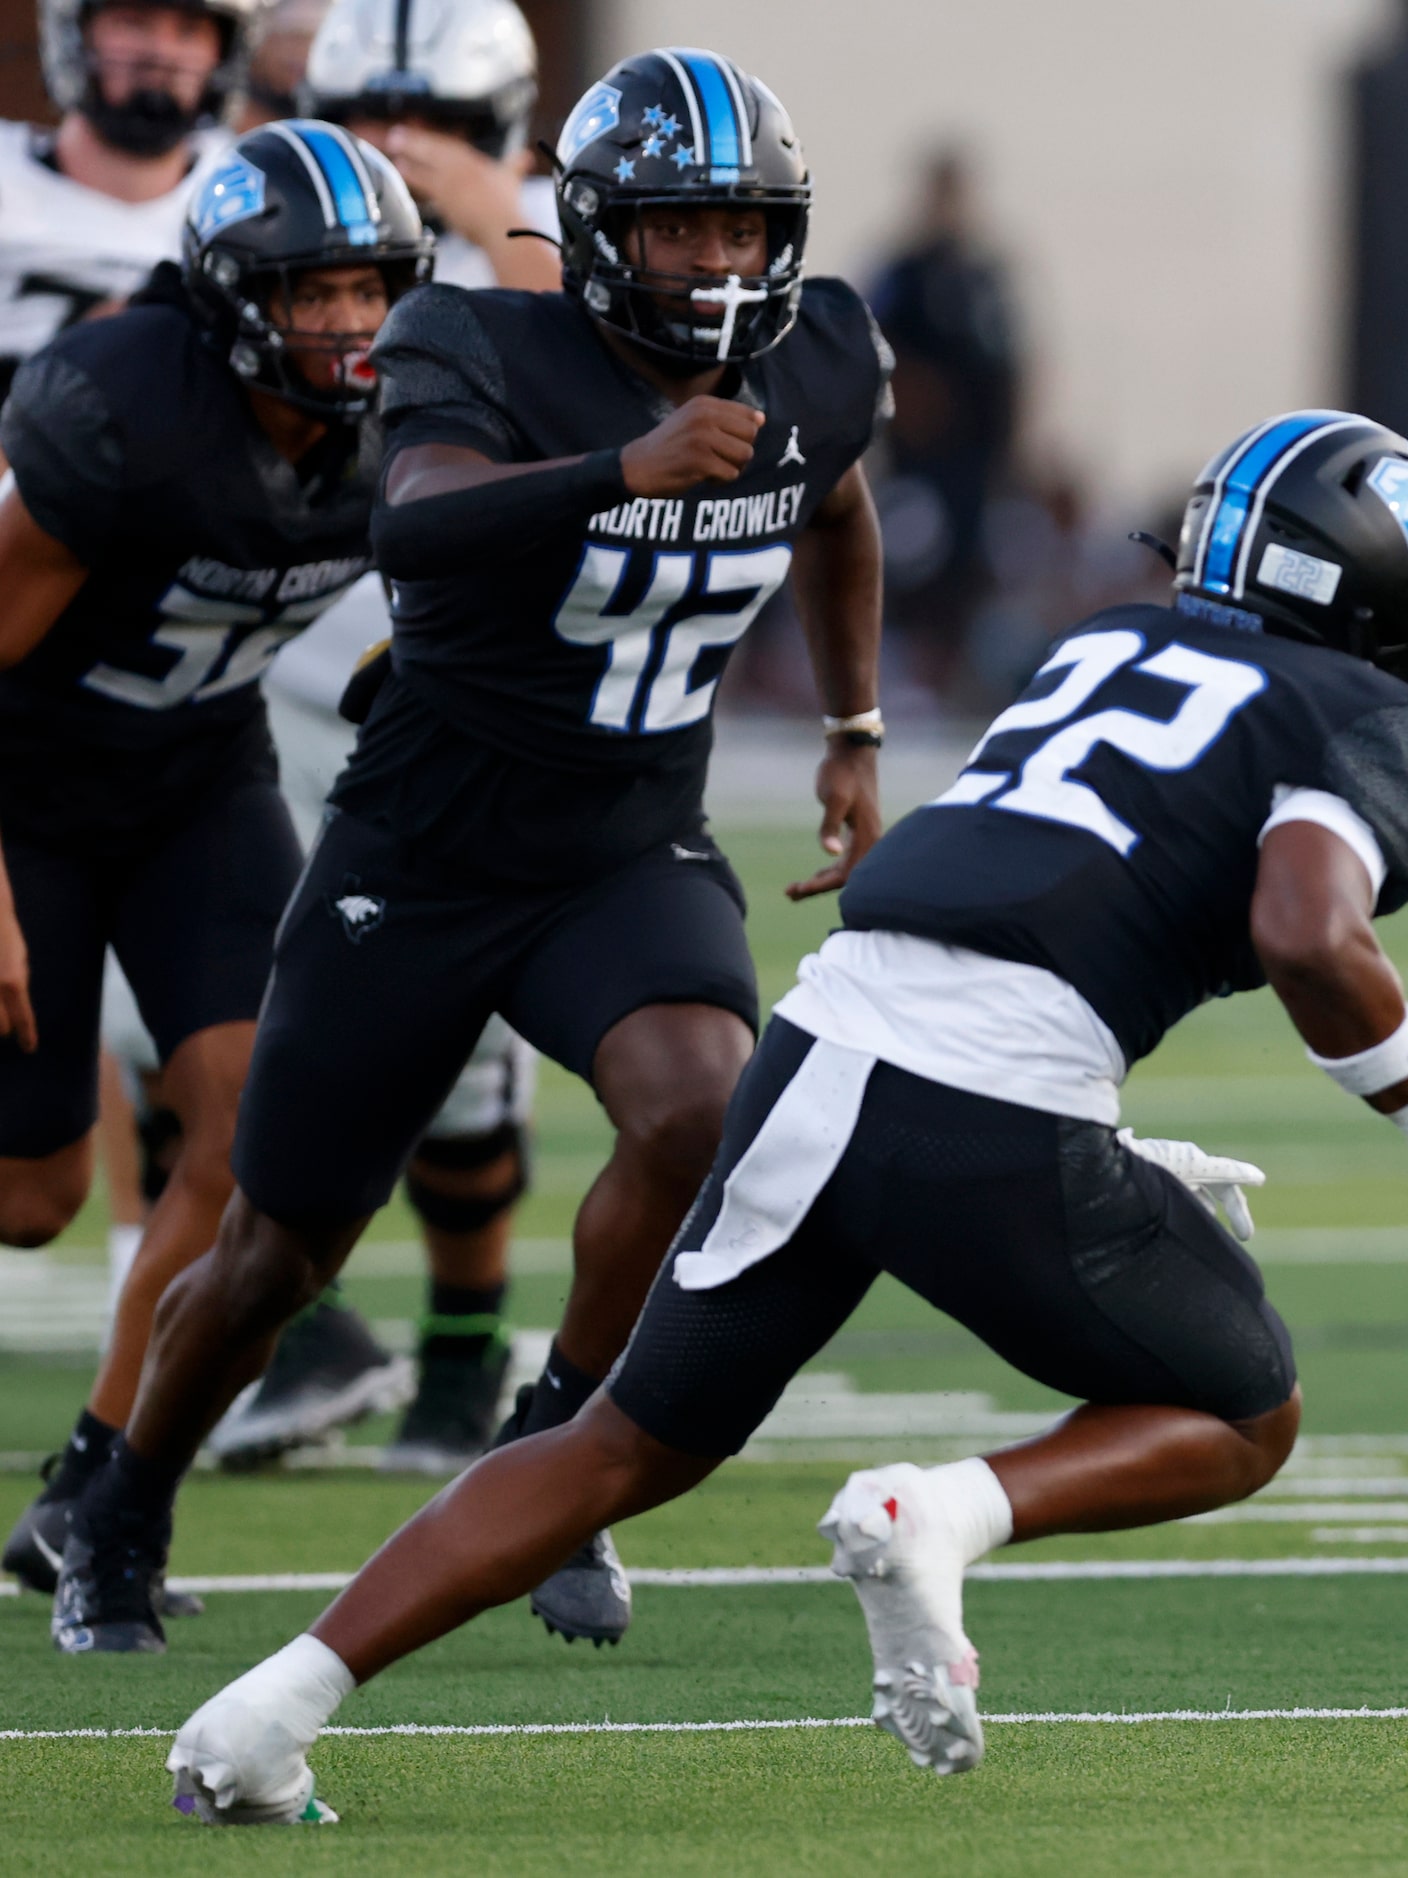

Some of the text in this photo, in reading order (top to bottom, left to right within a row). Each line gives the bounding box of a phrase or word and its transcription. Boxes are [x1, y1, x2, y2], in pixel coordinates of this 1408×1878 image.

[588, 482, 807, 542] NORTH CROWLEY
[1275, 549, 1323, 598] 22
[553, 541, 794, 735] 42
[922, 628, 1270, 860] 22
